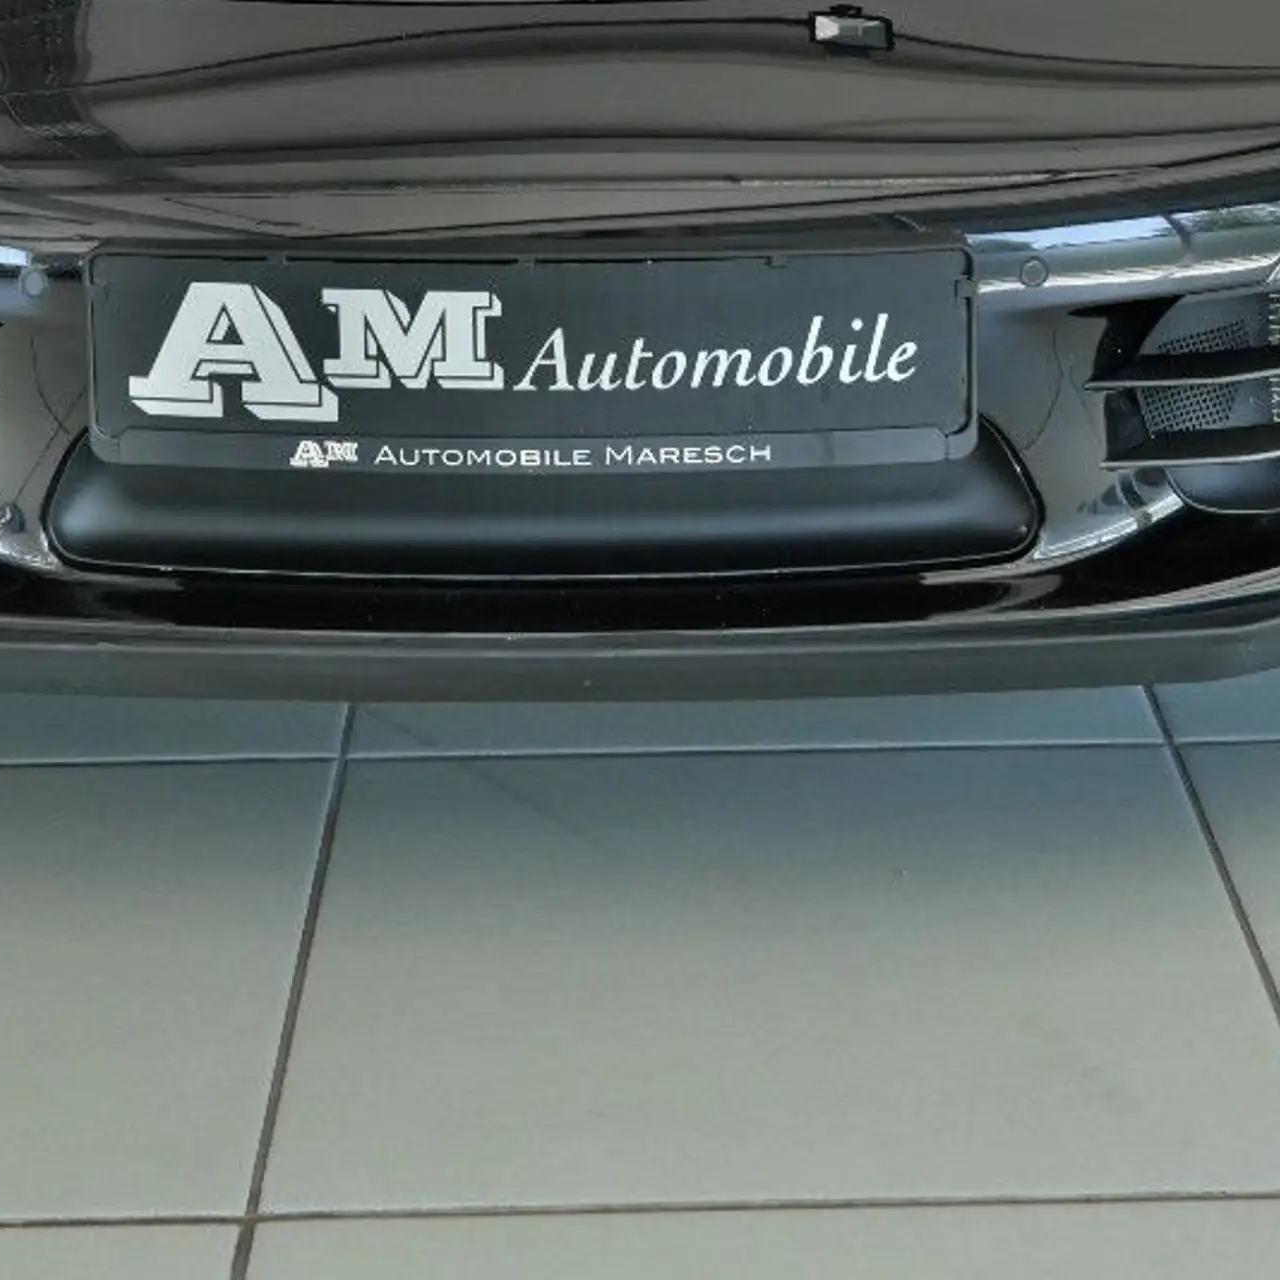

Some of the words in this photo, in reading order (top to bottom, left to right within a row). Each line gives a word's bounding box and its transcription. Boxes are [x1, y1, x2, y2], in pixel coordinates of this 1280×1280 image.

[129, 282, 505, 422] AM
[513, 313, 918, 392] Automobile
[289, 439, 358, 468] AM
[373, 445, 592, 466] AUTOMOBILE
[605, 444, 772, 466] MARESCH
